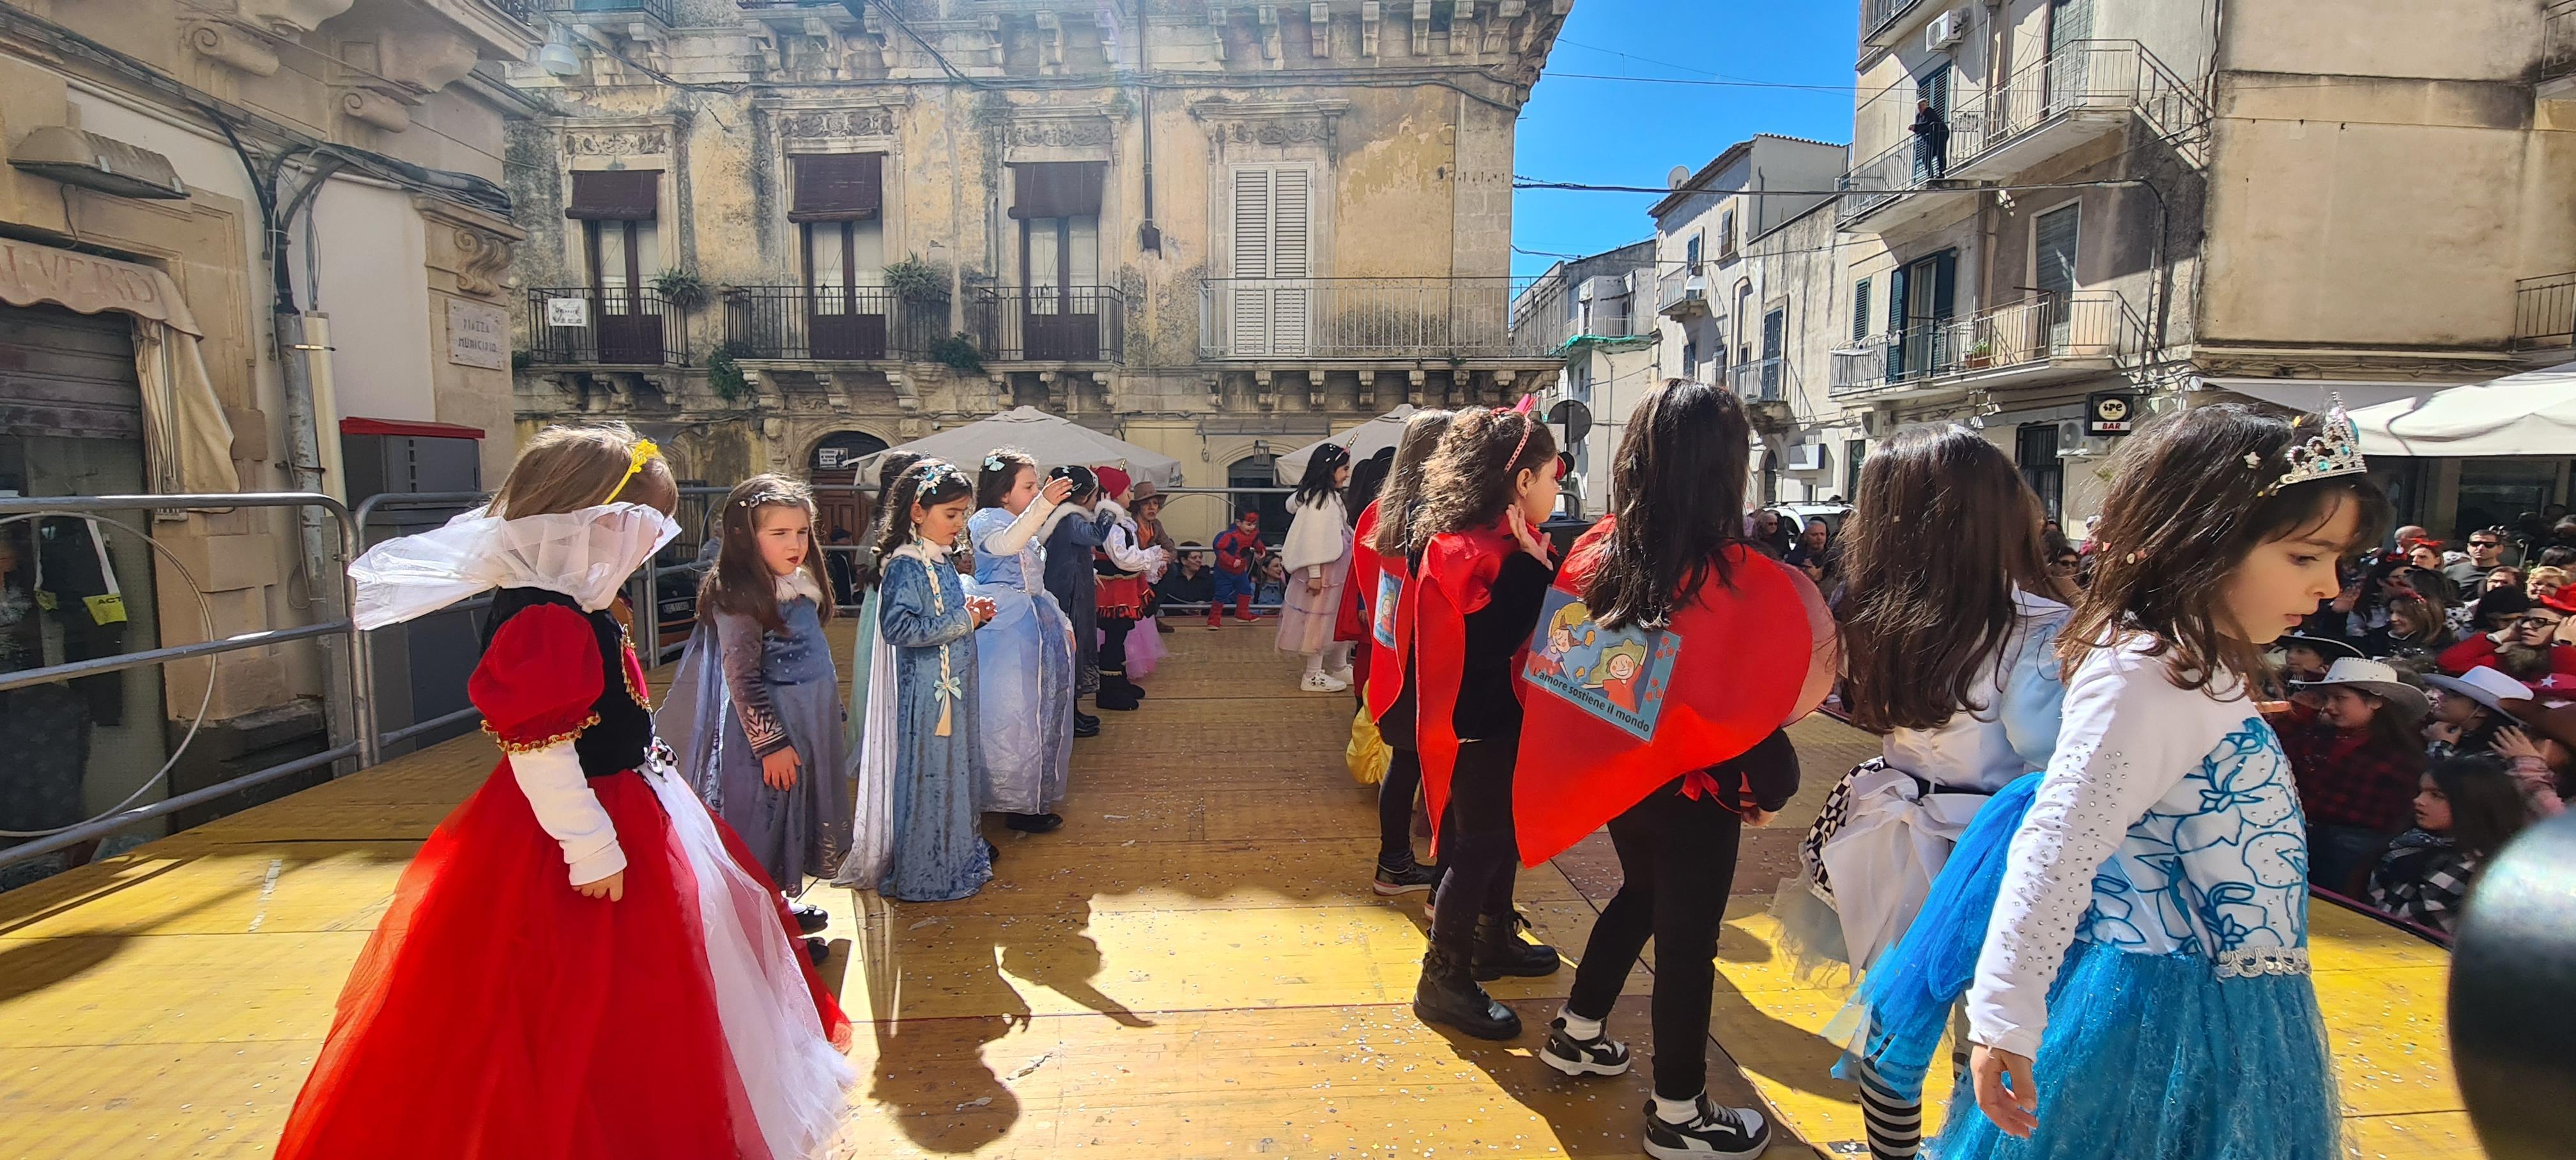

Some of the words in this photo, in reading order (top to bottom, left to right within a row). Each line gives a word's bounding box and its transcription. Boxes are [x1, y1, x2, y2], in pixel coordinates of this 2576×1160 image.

[463, 319, 489, 333] PIAZZA
[459, 337, 496, 353] MUNICIPIO
[1533, 668, 1568, 691] L'amore
[1568, 685, 1606, 710] sostiene
[1607, 703, 1614, 714] il
[1616, 708, 1650, 732] mondo
